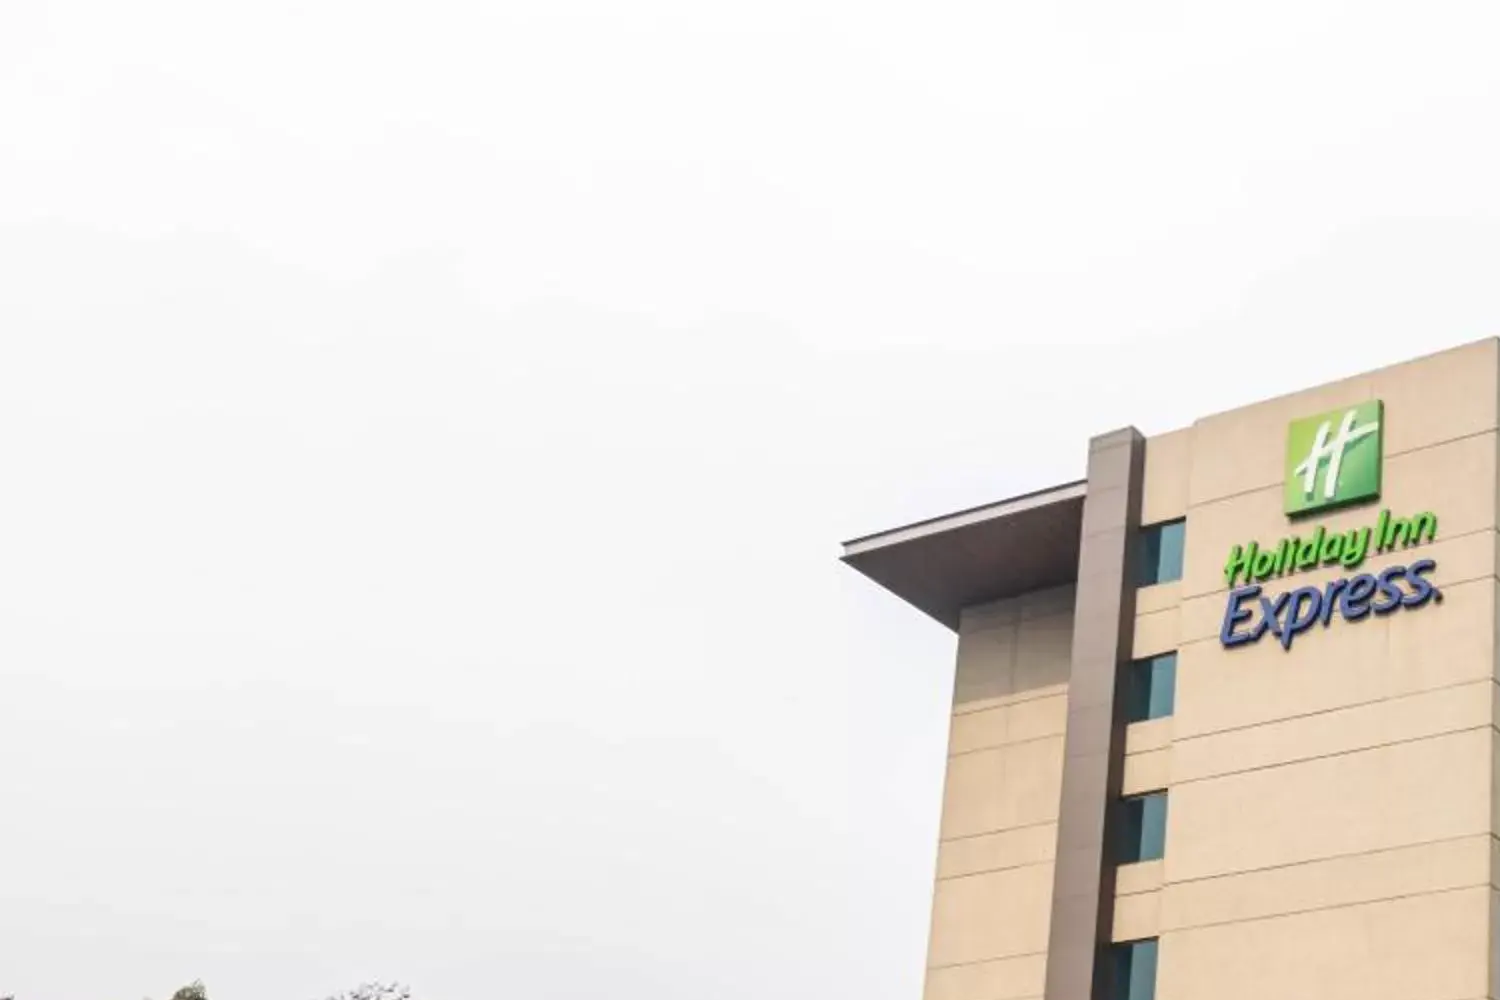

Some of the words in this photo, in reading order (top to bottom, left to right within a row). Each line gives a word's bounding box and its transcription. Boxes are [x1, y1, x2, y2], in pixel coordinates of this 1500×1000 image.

[1294, 409, 1379, 500] H
[1224, 525, 1371, 587] Holiday
[1374, 508, 1438, 552] Inn
[1219, 559, 1438, 651] Express
